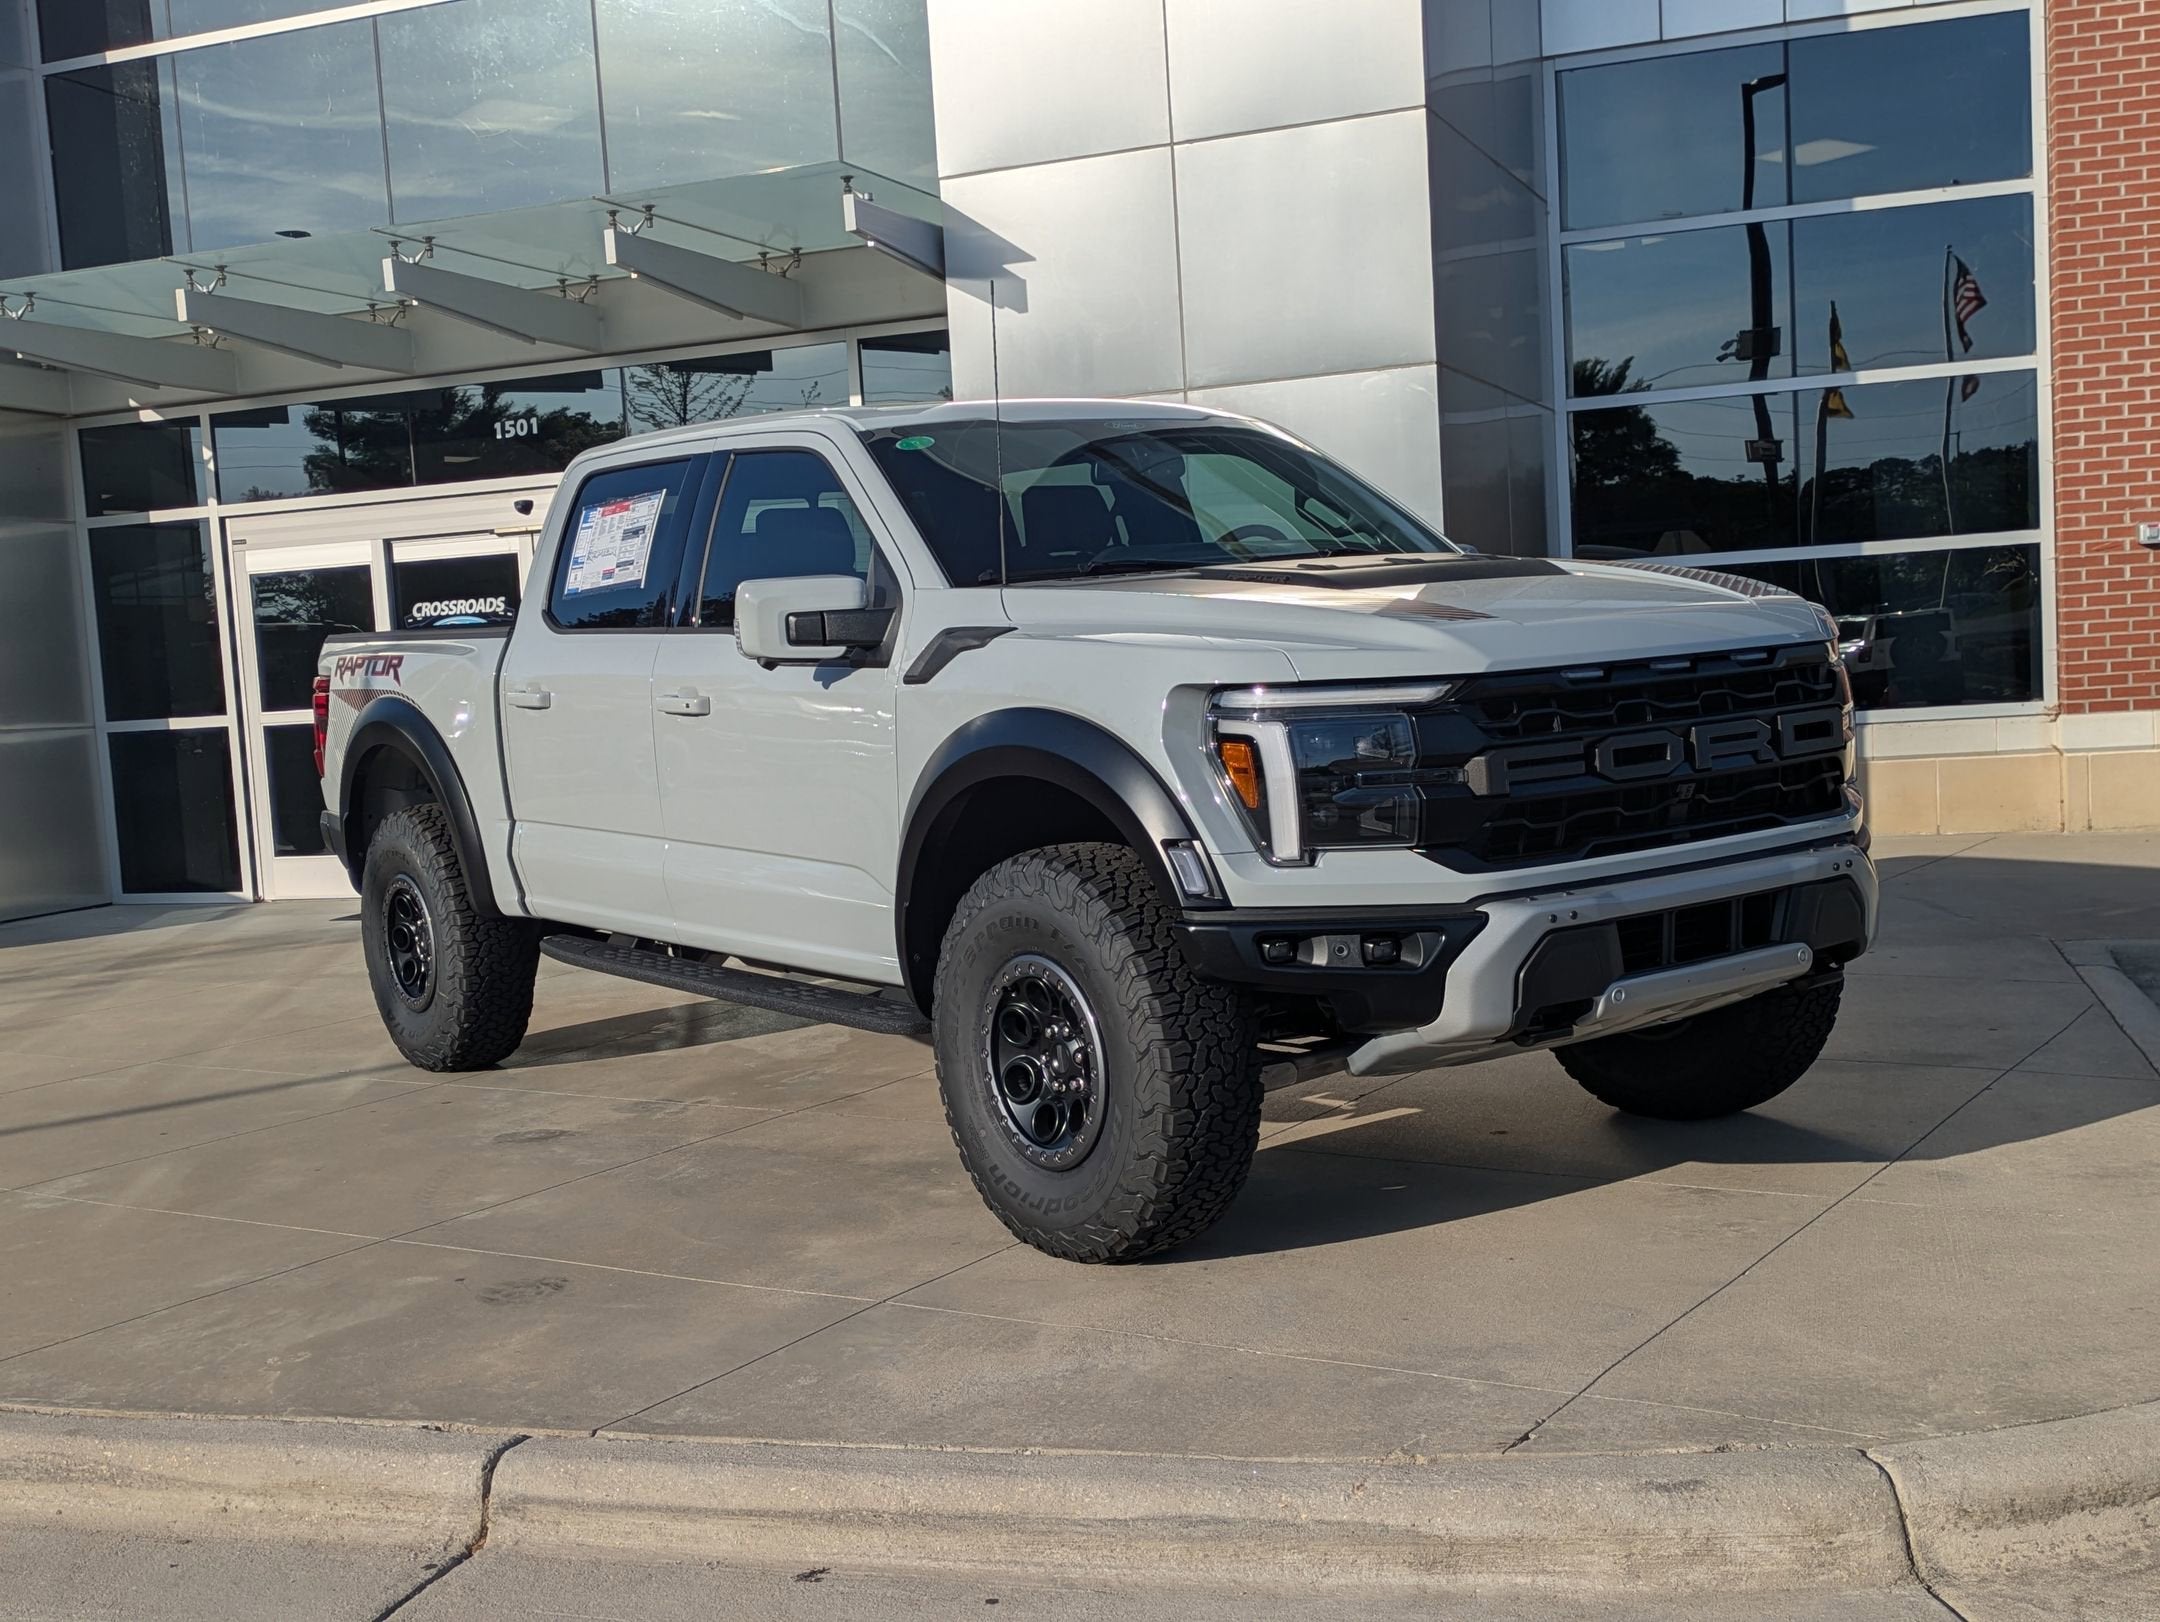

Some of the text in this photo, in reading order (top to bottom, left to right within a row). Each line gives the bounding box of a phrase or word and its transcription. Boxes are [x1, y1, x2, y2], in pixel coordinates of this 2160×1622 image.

[494, 417, 538, 440] 1501
[412, 596, 506, 618] CROSSROADS
[334, 654, 405, 687] RAPTOR
[1465, 706, 1846, 796] FORD
